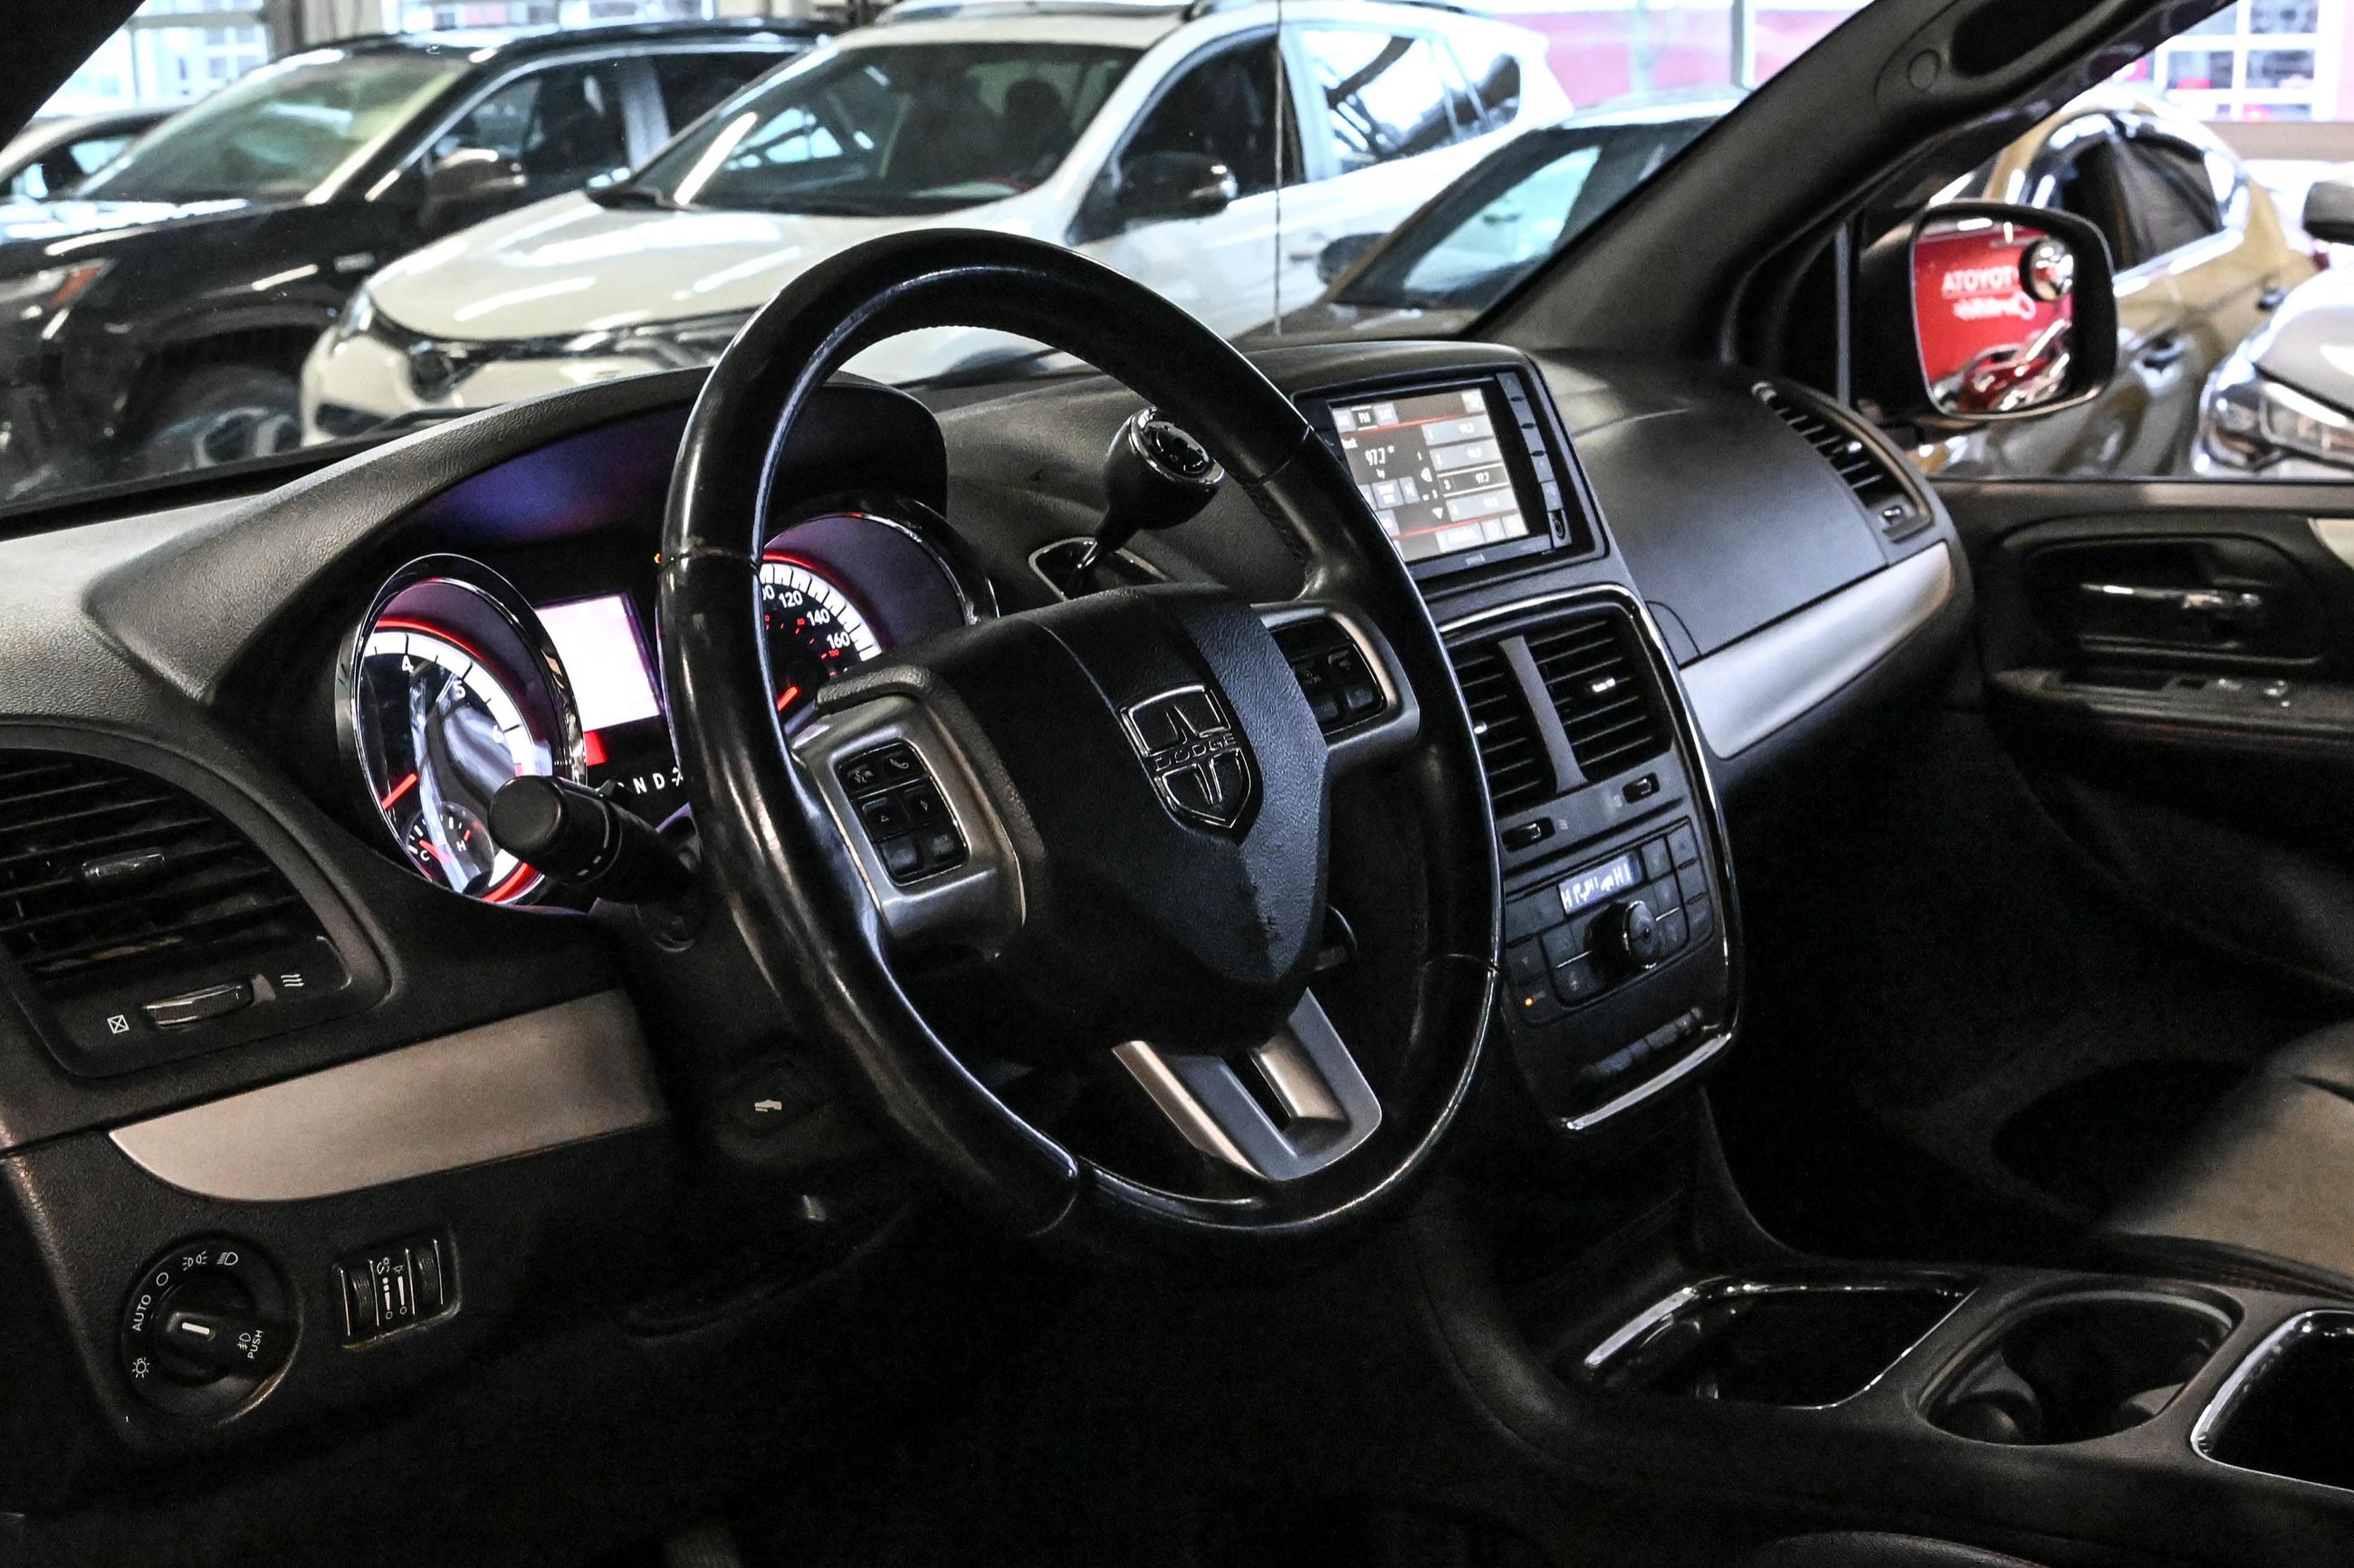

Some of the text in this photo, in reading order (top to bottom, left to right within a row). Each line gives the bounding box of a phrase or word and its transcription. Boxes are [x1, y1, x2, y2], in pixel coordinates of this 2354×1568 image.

[1358, 412, 1372, 424] FM
[779, 590, 803, 608] 120
[807, 608, 830, 626] 140
[827, 632, 850, 649] 160
[401, 655, 415, 673] 4
[453, 680, 466, 700] 5
[1153, 732, 1237, 772] DODGE
[633, 772, 665, 795] N D
[455, 839, 467, 852] H
[420, 850, 430, 861] C
[132, 1294, 152, 1332] AUTO
[246, 1329, 263, 1359] PUSH
